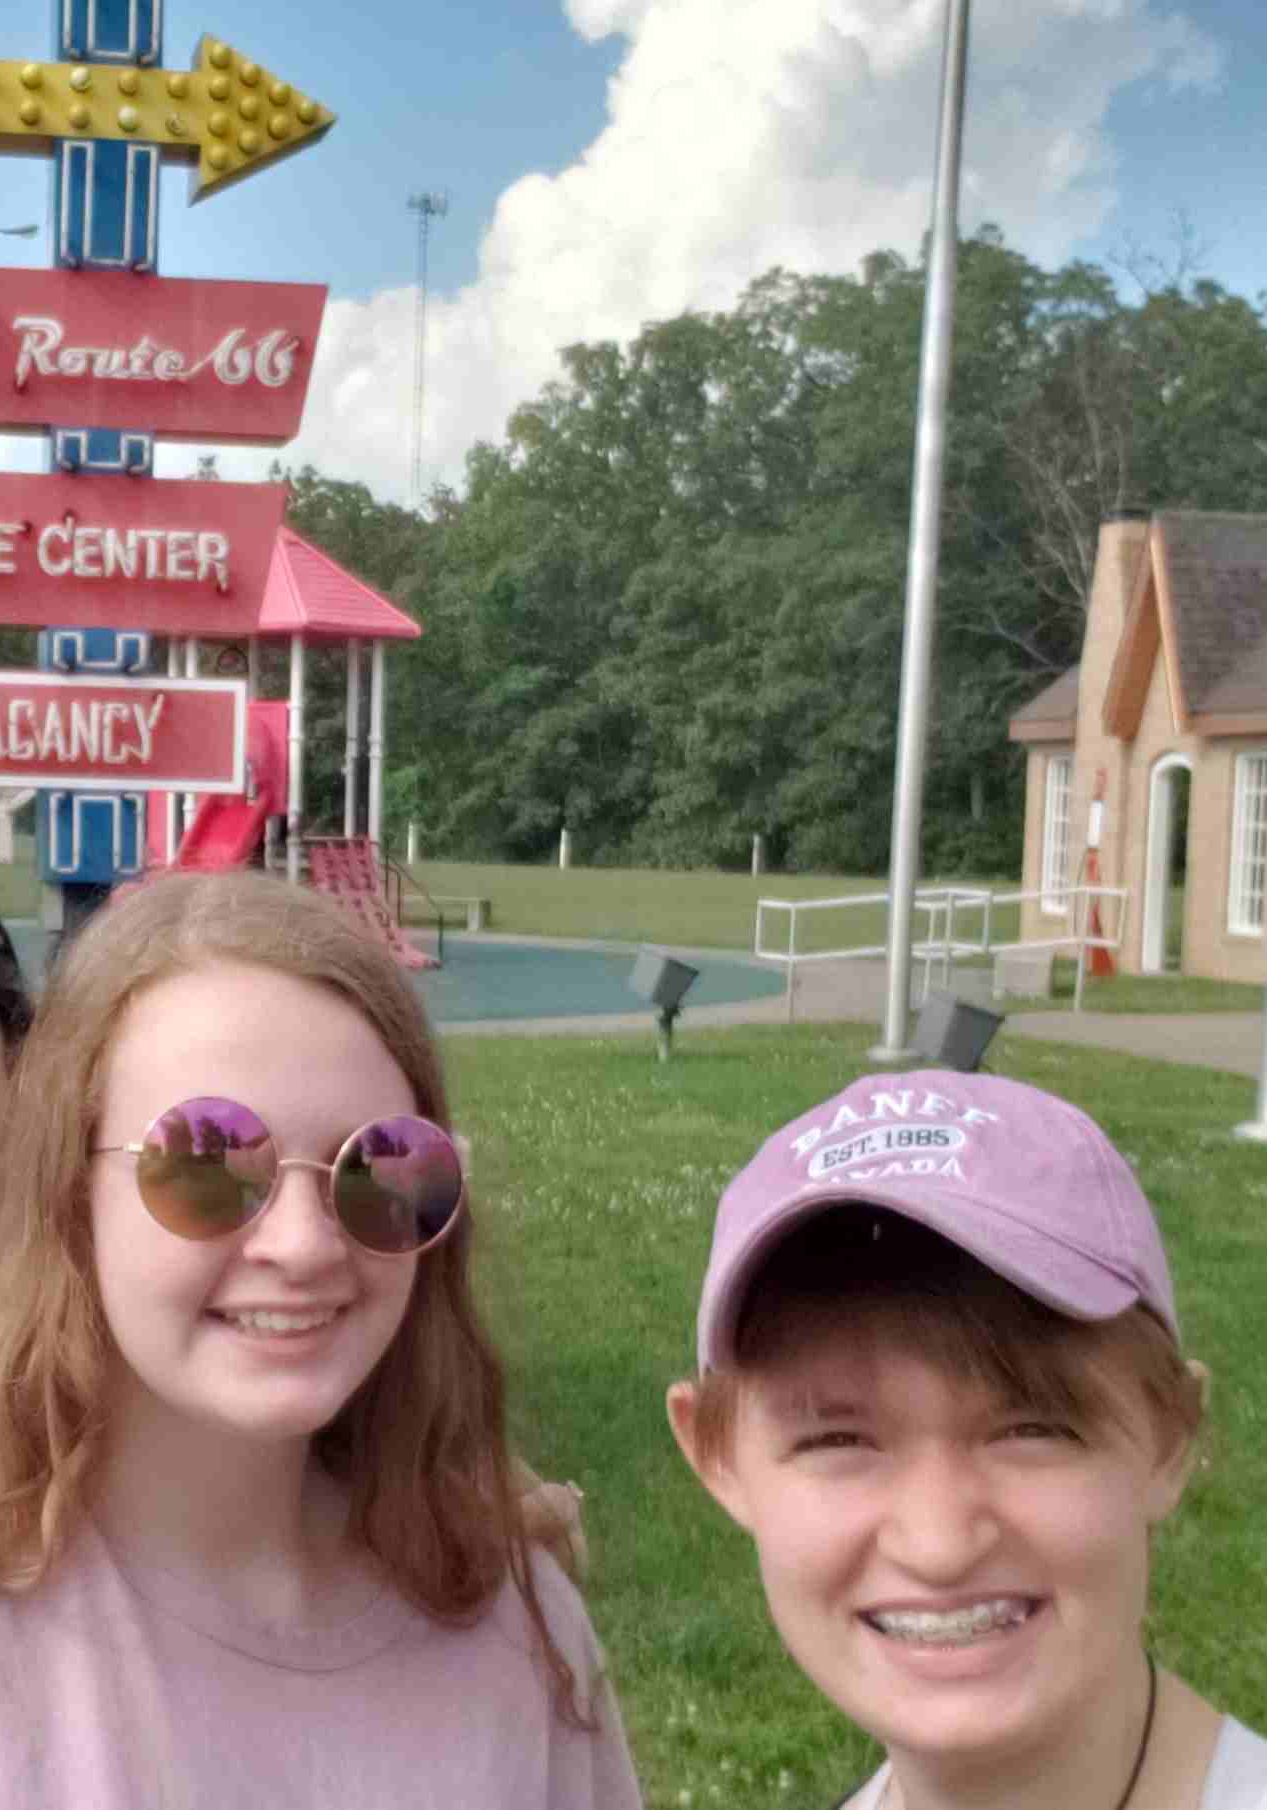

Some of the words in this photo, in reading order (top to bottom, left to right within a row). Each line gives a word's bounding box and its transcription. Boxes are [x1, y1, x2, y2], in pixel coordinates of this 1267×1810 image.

[13, 317, 197, 385] Route
[212, 328, 299, 387] 66
[37, 517, 229, 591] CENTER
[821, 1135, 878, 1169] EST.
